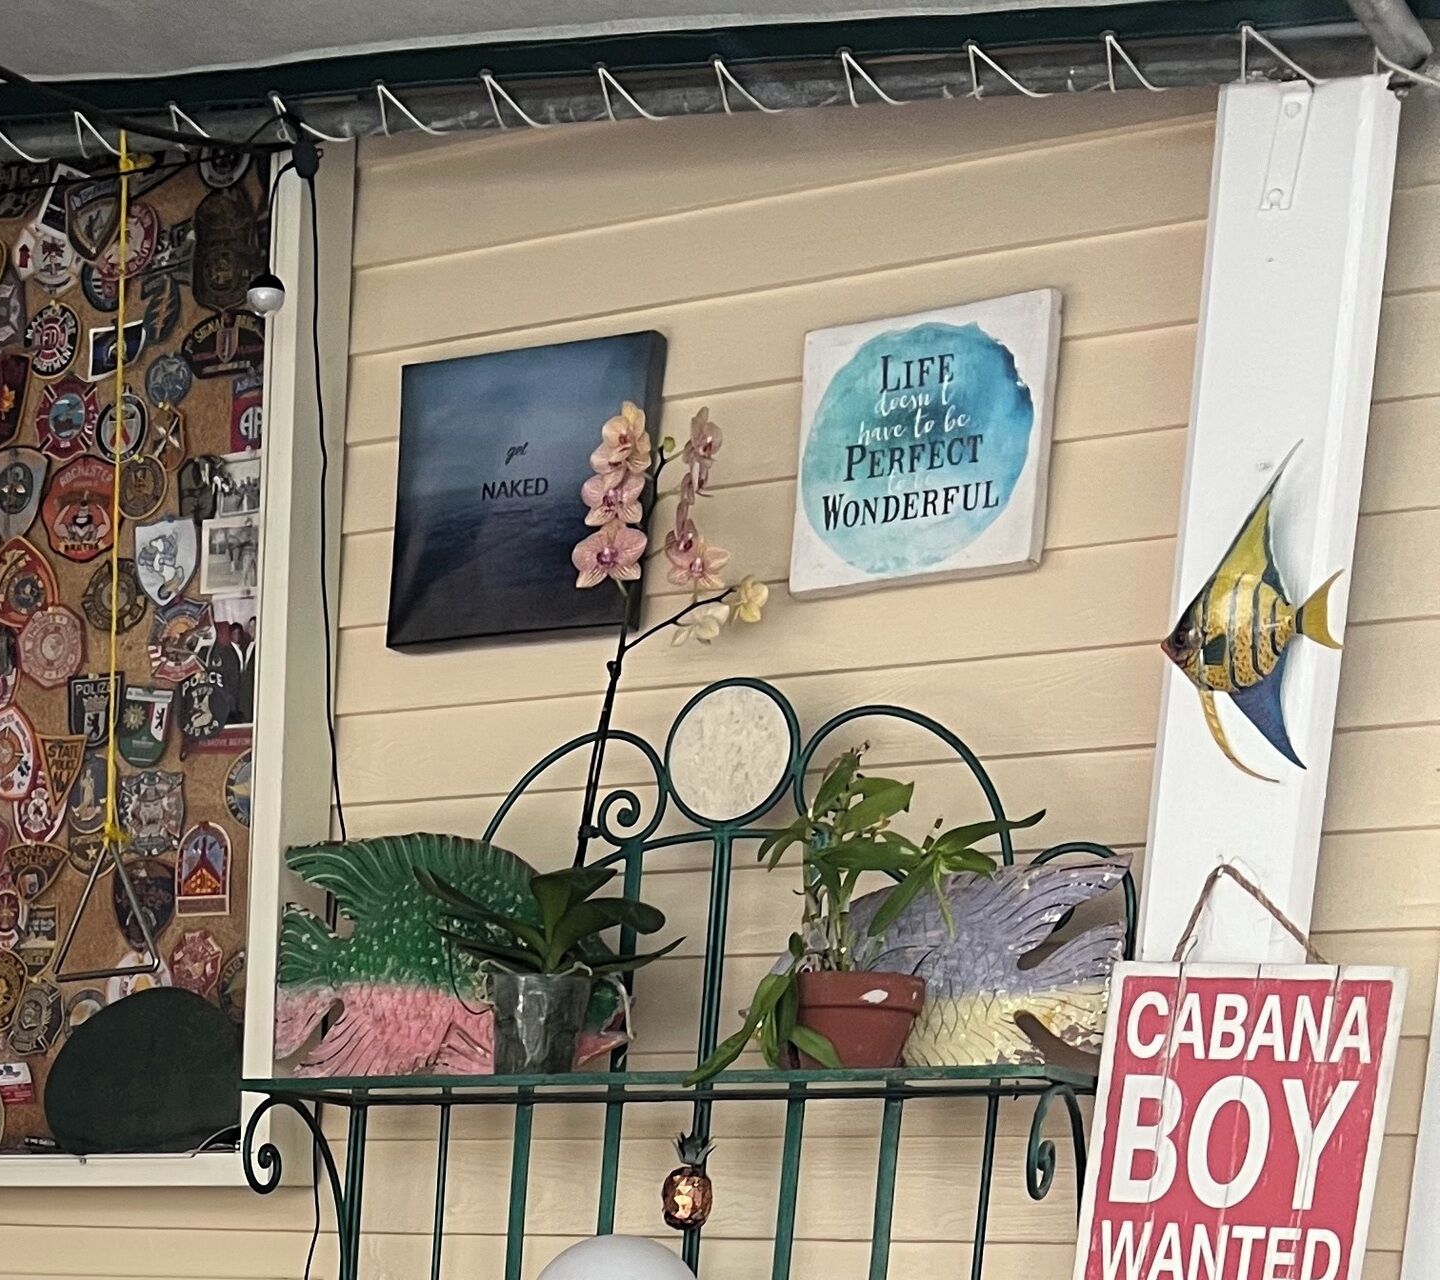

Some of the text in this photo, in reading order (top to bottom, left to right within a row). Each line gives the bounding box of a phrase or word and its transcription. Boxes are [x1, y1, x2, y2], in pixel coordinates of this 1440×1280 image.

[878, 352, 956, 394] LIFE
[857, 404, 972, 447] have to be
[505, 441, 529, 465] get
[843, 433, 984, 483] PERFECT
[482, 476, 549, 501] NAKED
[822, 479, 1000, 532] WONDERFUL
[1126, 991, 1371, 1064] CABANA
[1108, 1073, 1360, 1211] BOY
